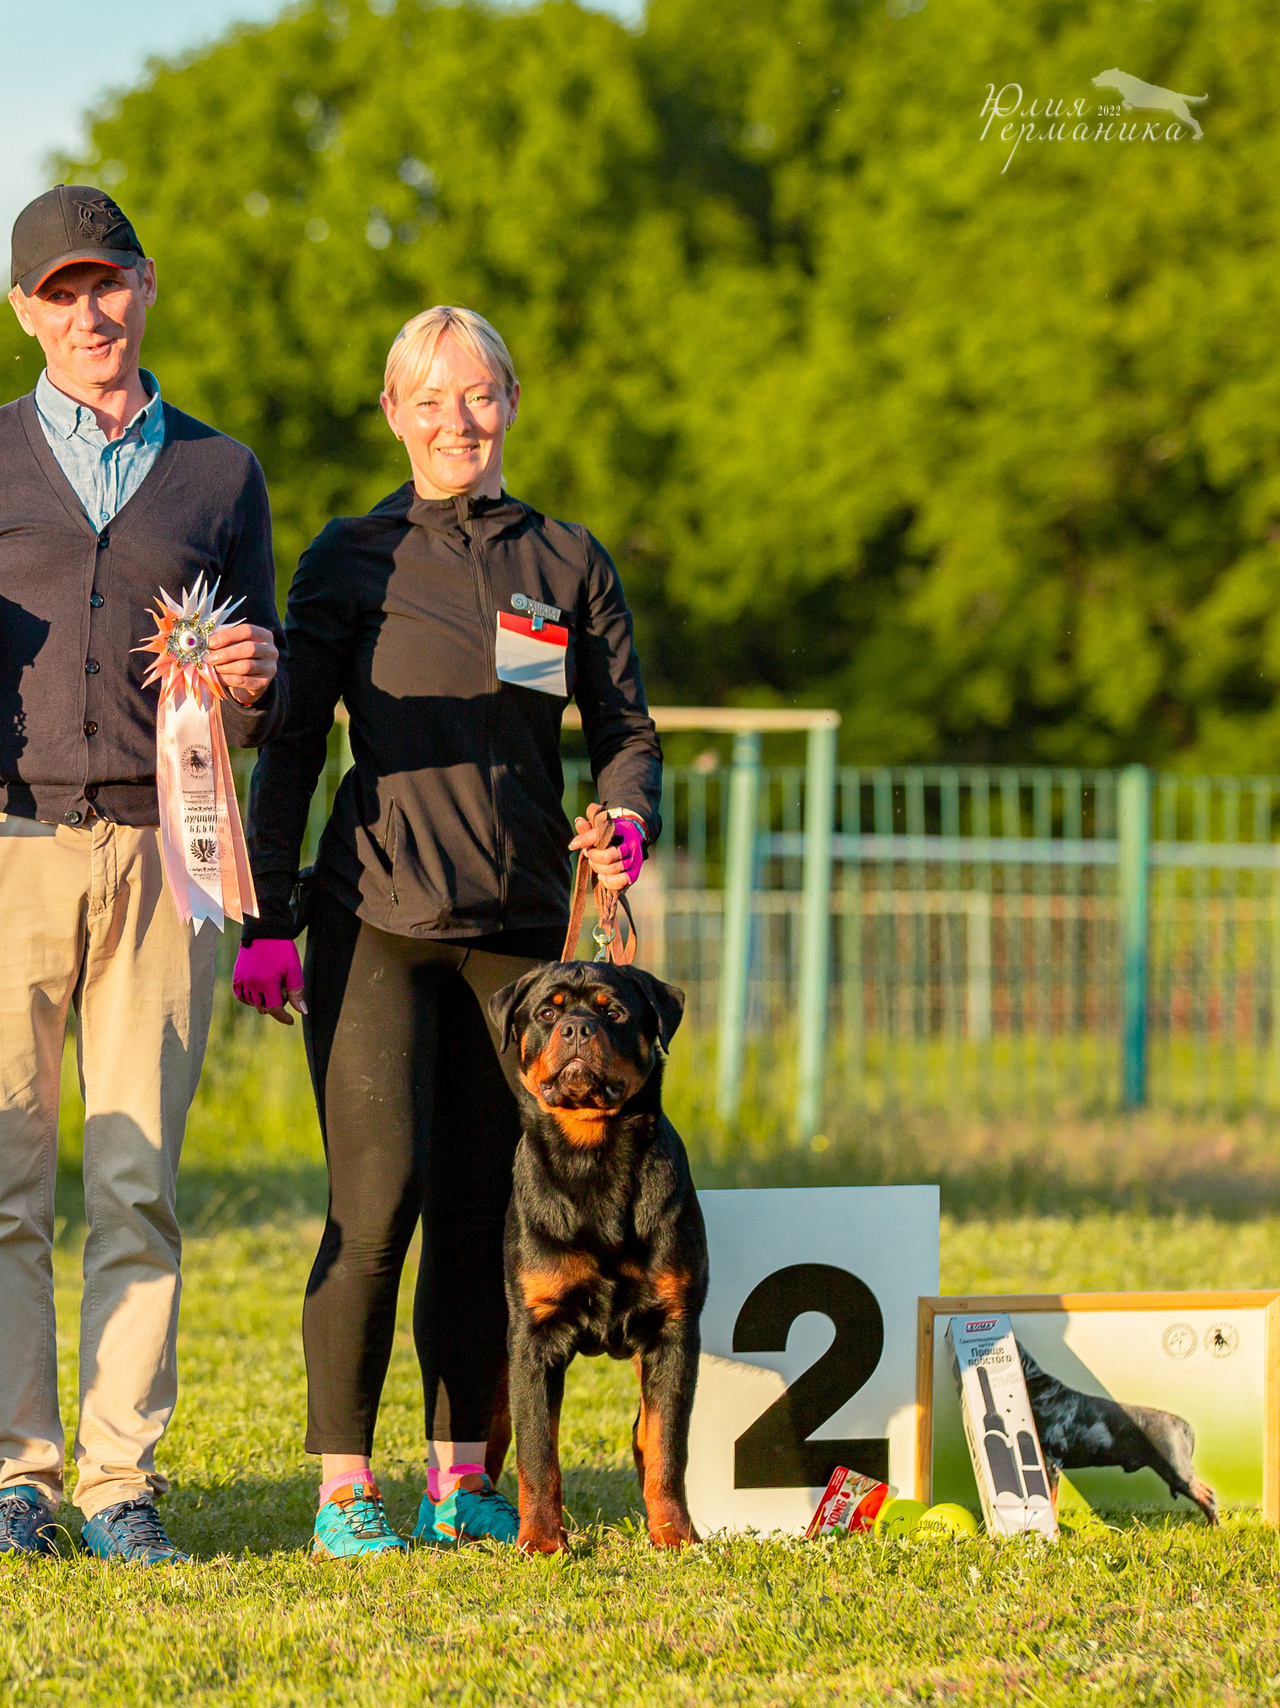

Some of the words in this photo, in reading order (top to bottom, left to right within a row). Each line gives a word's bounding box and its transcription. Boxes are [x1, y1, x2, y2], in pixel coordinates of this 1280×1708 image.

[968, 1355, 1012, 1367] простого
[971, 1347, 1005, 1358] Проще
[733, 1263, 889, 1489] 2
[826, 1499, 847, 1527] KONG
